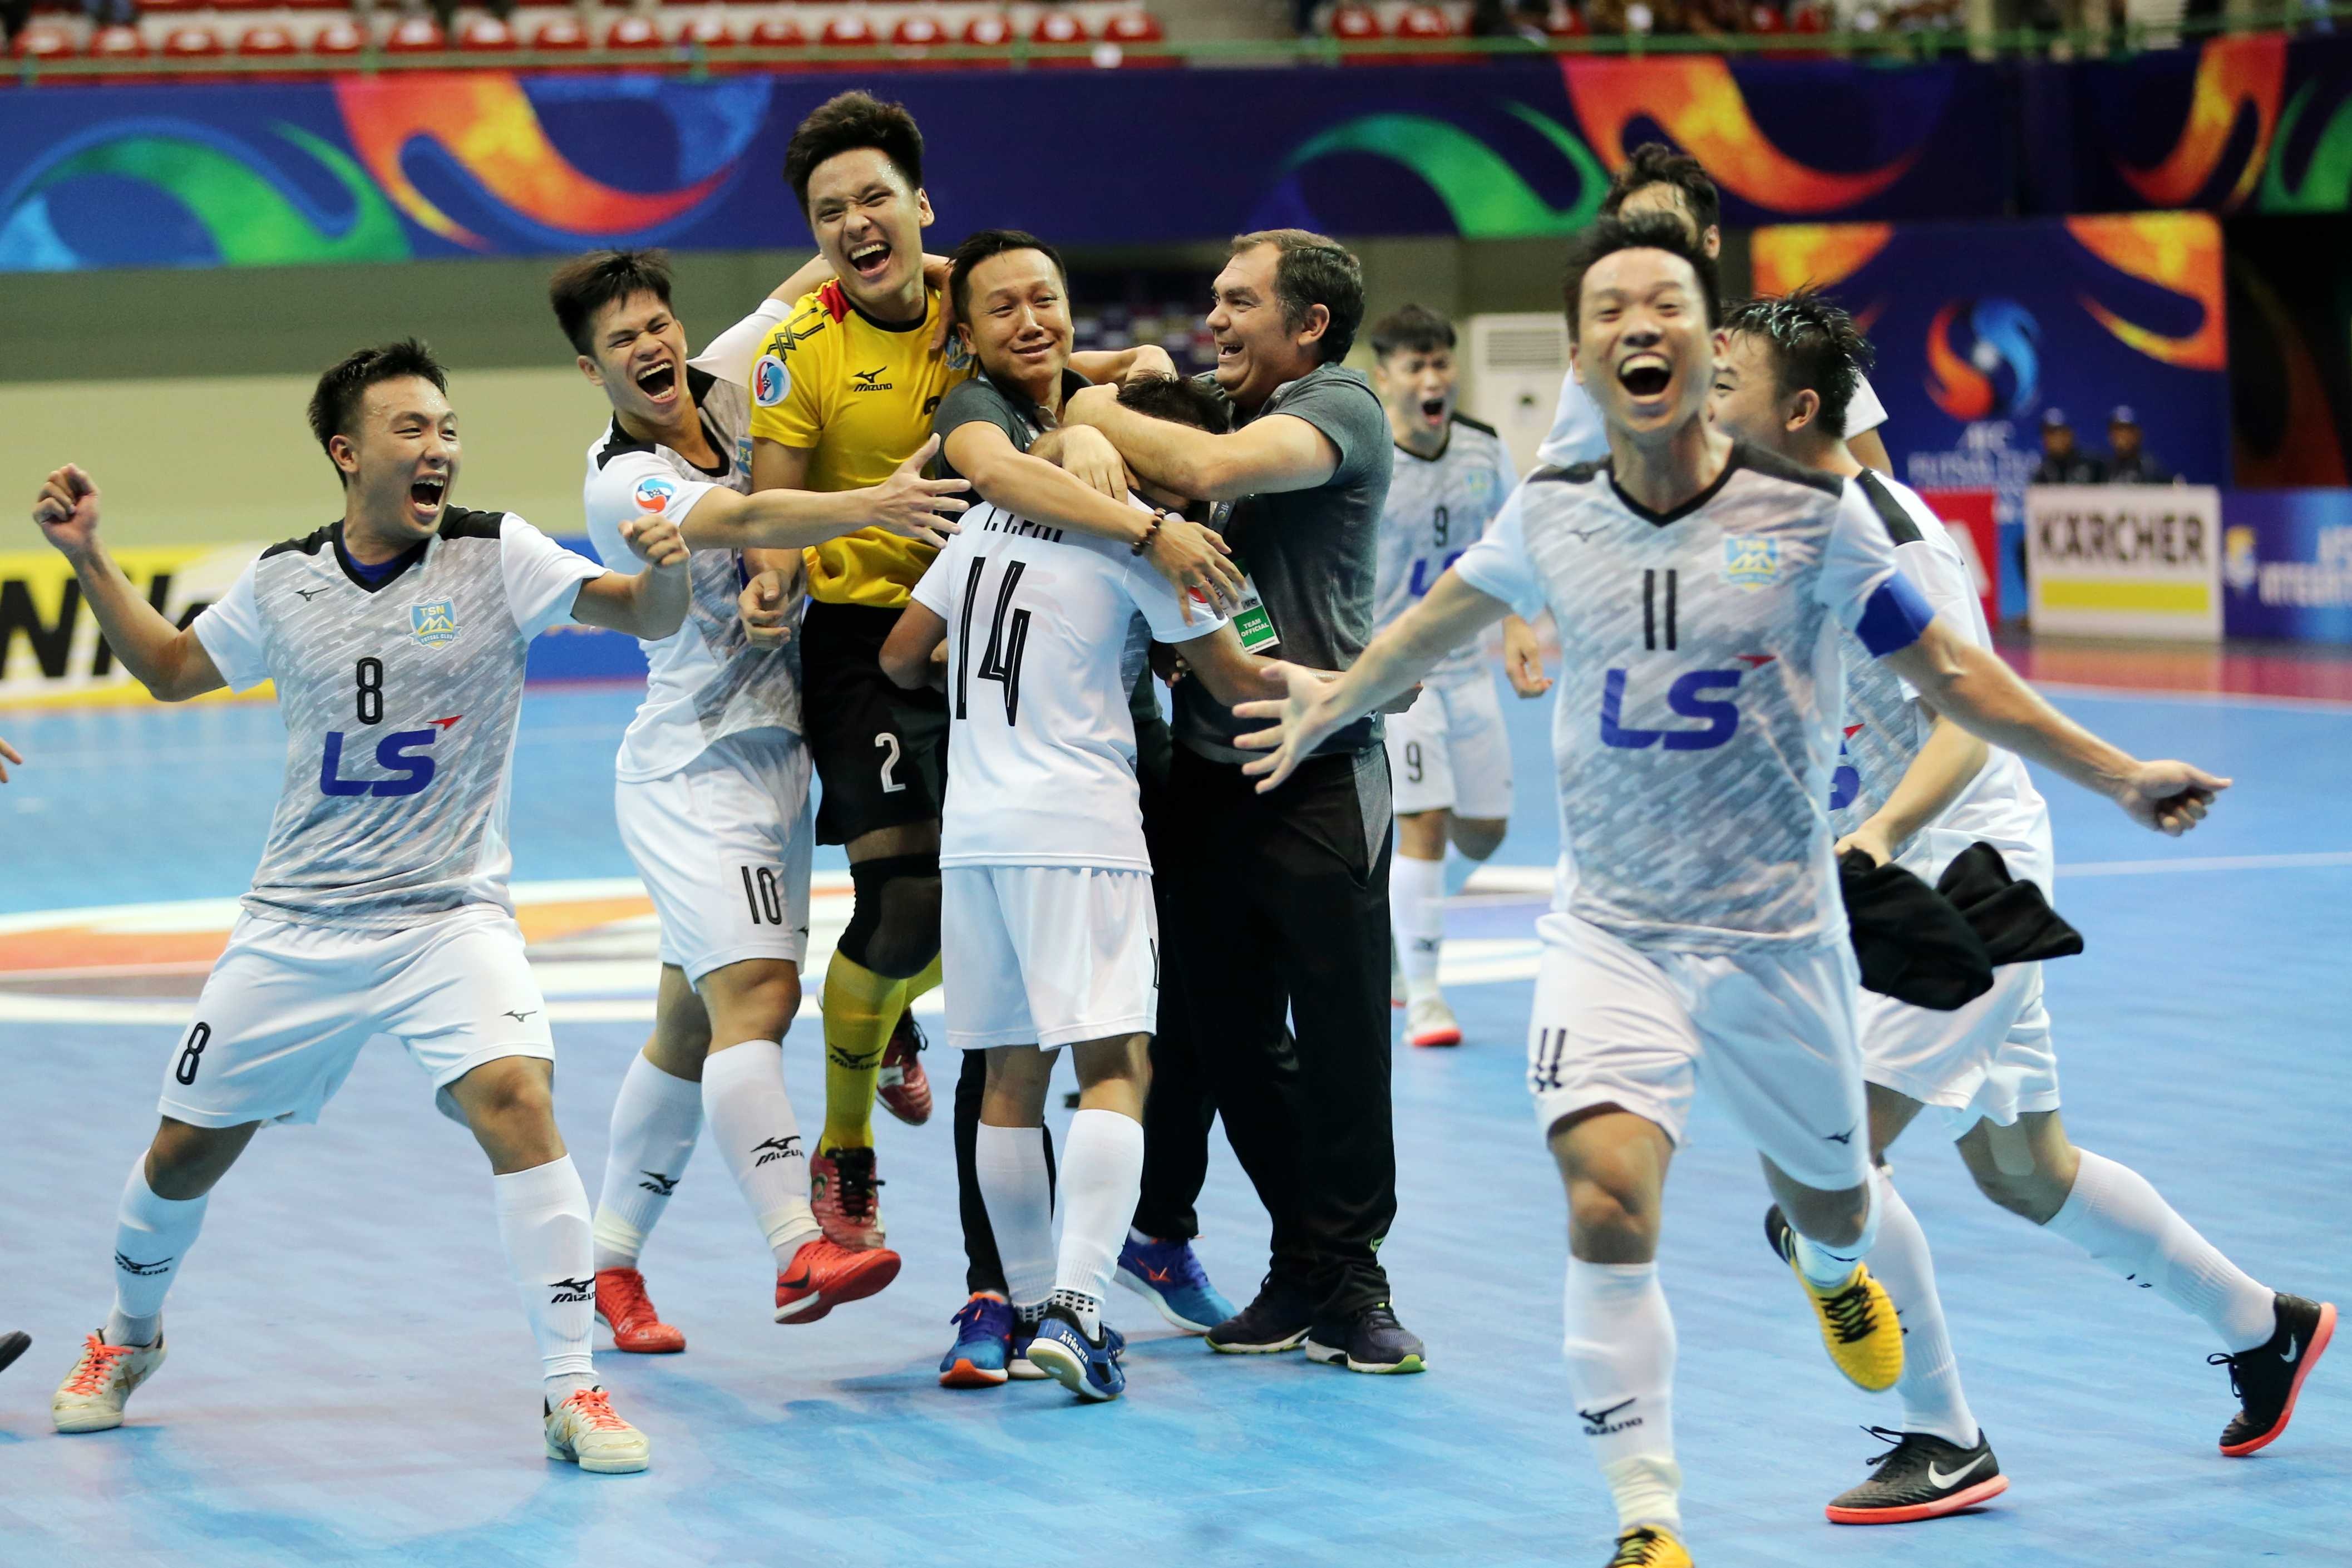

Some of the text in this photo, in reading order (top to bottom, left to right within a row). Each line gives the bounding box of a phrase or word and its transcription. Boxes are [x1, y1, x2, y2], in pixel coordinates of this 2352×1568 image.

[854, 383, 893, 392] MIZUNO
[1433, 504, 1449, 548] 9
[419, 605, 446, 617] TSN
[1240, 622, 1270, 637] OFFICIAL
[1242, 618, 1262, 629] TEAM
[1644, 569, 1677, 650] 11
[956, 556, 1032, 727] 14
[356, 657, 383, 725] 8
[1600, 668, 1742, 751] LS
[319, 728, 436, 797] LS
[875, 732, 906, 793] 2
[1406, 741, 1423, 782] 9
[741, 865, 782, 925] 10
[176, 1022, 211, 1086] 8
